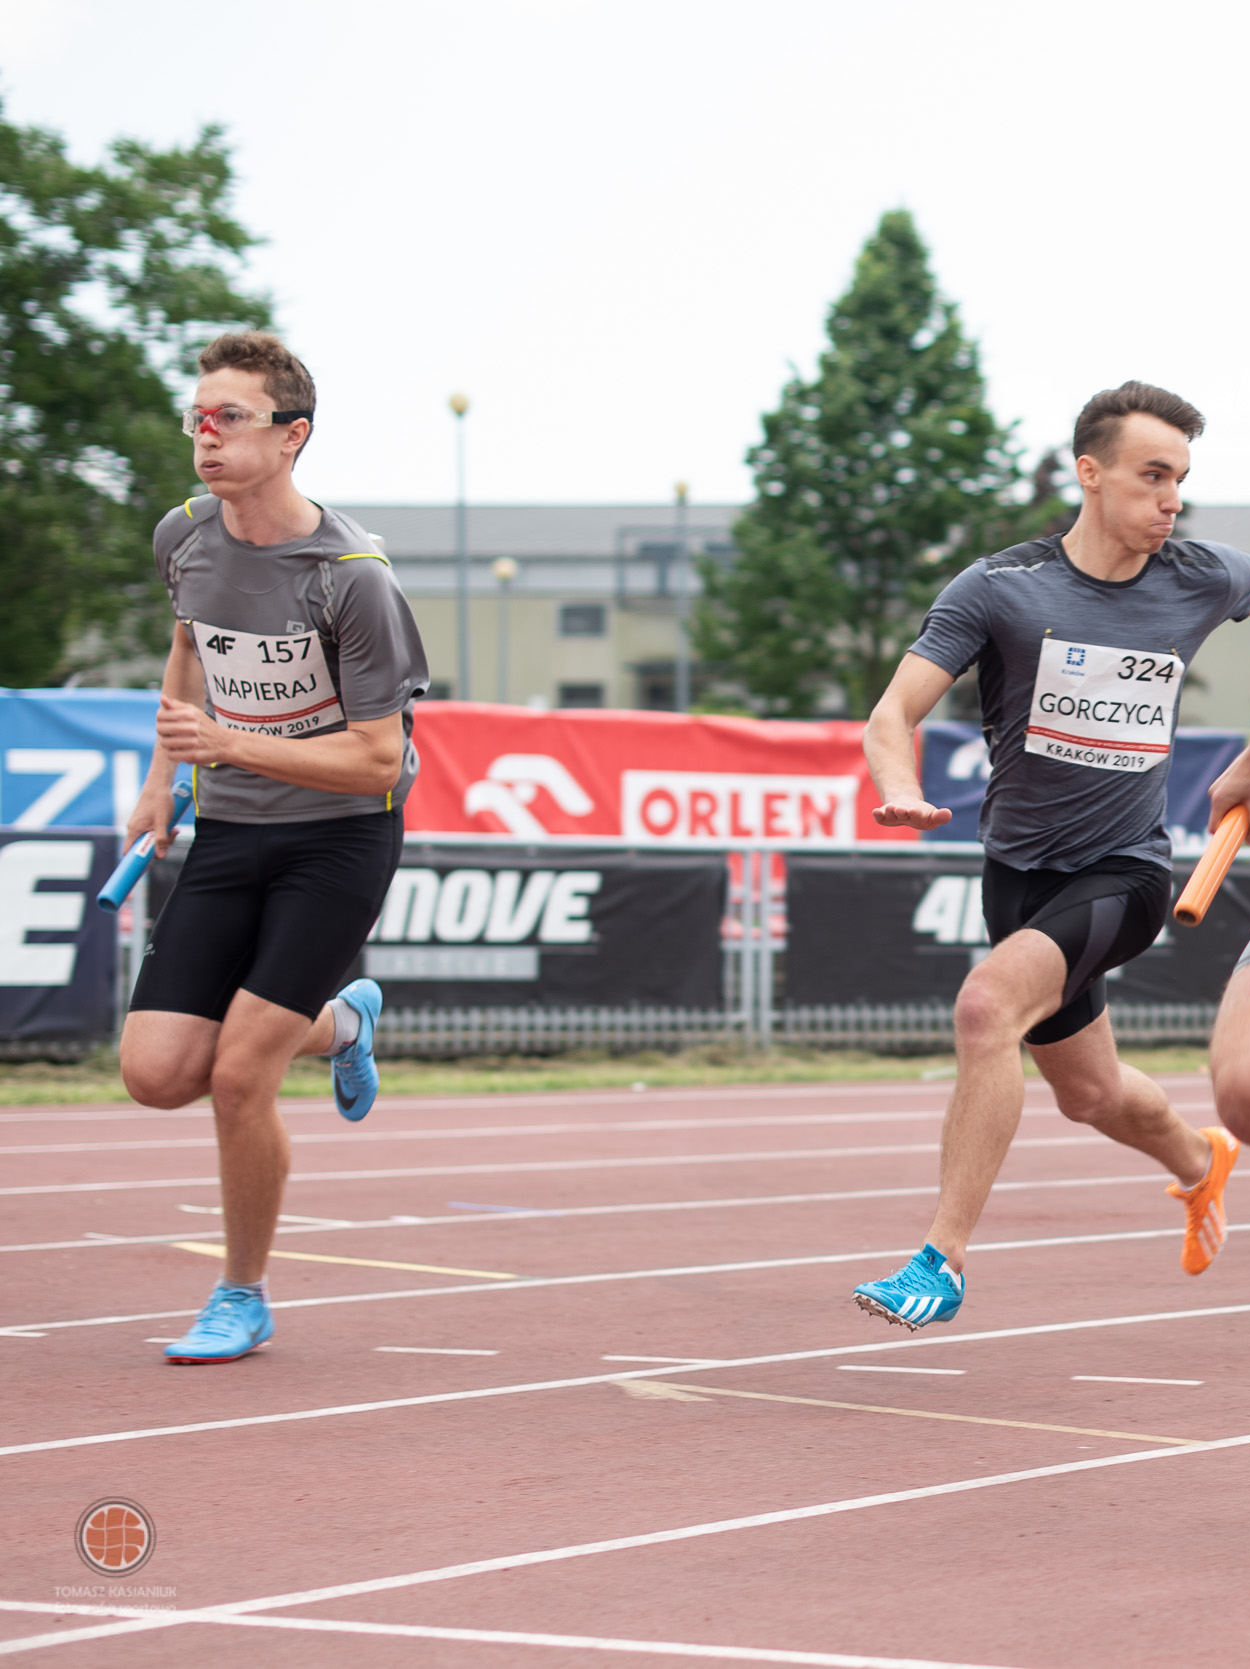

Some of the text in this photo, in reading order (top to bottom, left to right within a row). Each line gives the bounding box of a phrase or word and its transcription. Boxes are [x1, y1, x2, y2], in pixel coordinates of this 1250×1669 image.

[206, 634, 312, 664] 4F 157
[1118, 656, 1174, 684] 324
[213, 673, 317, 701] NAPIERAJ
[1039, 692, 1165, 726] GORCZYCA
[287, 716, 320, 734] 2019
[1046, 743, 1146, 768] KRAKÓW 2019
[640, 788, 838, 837] ORLEN
